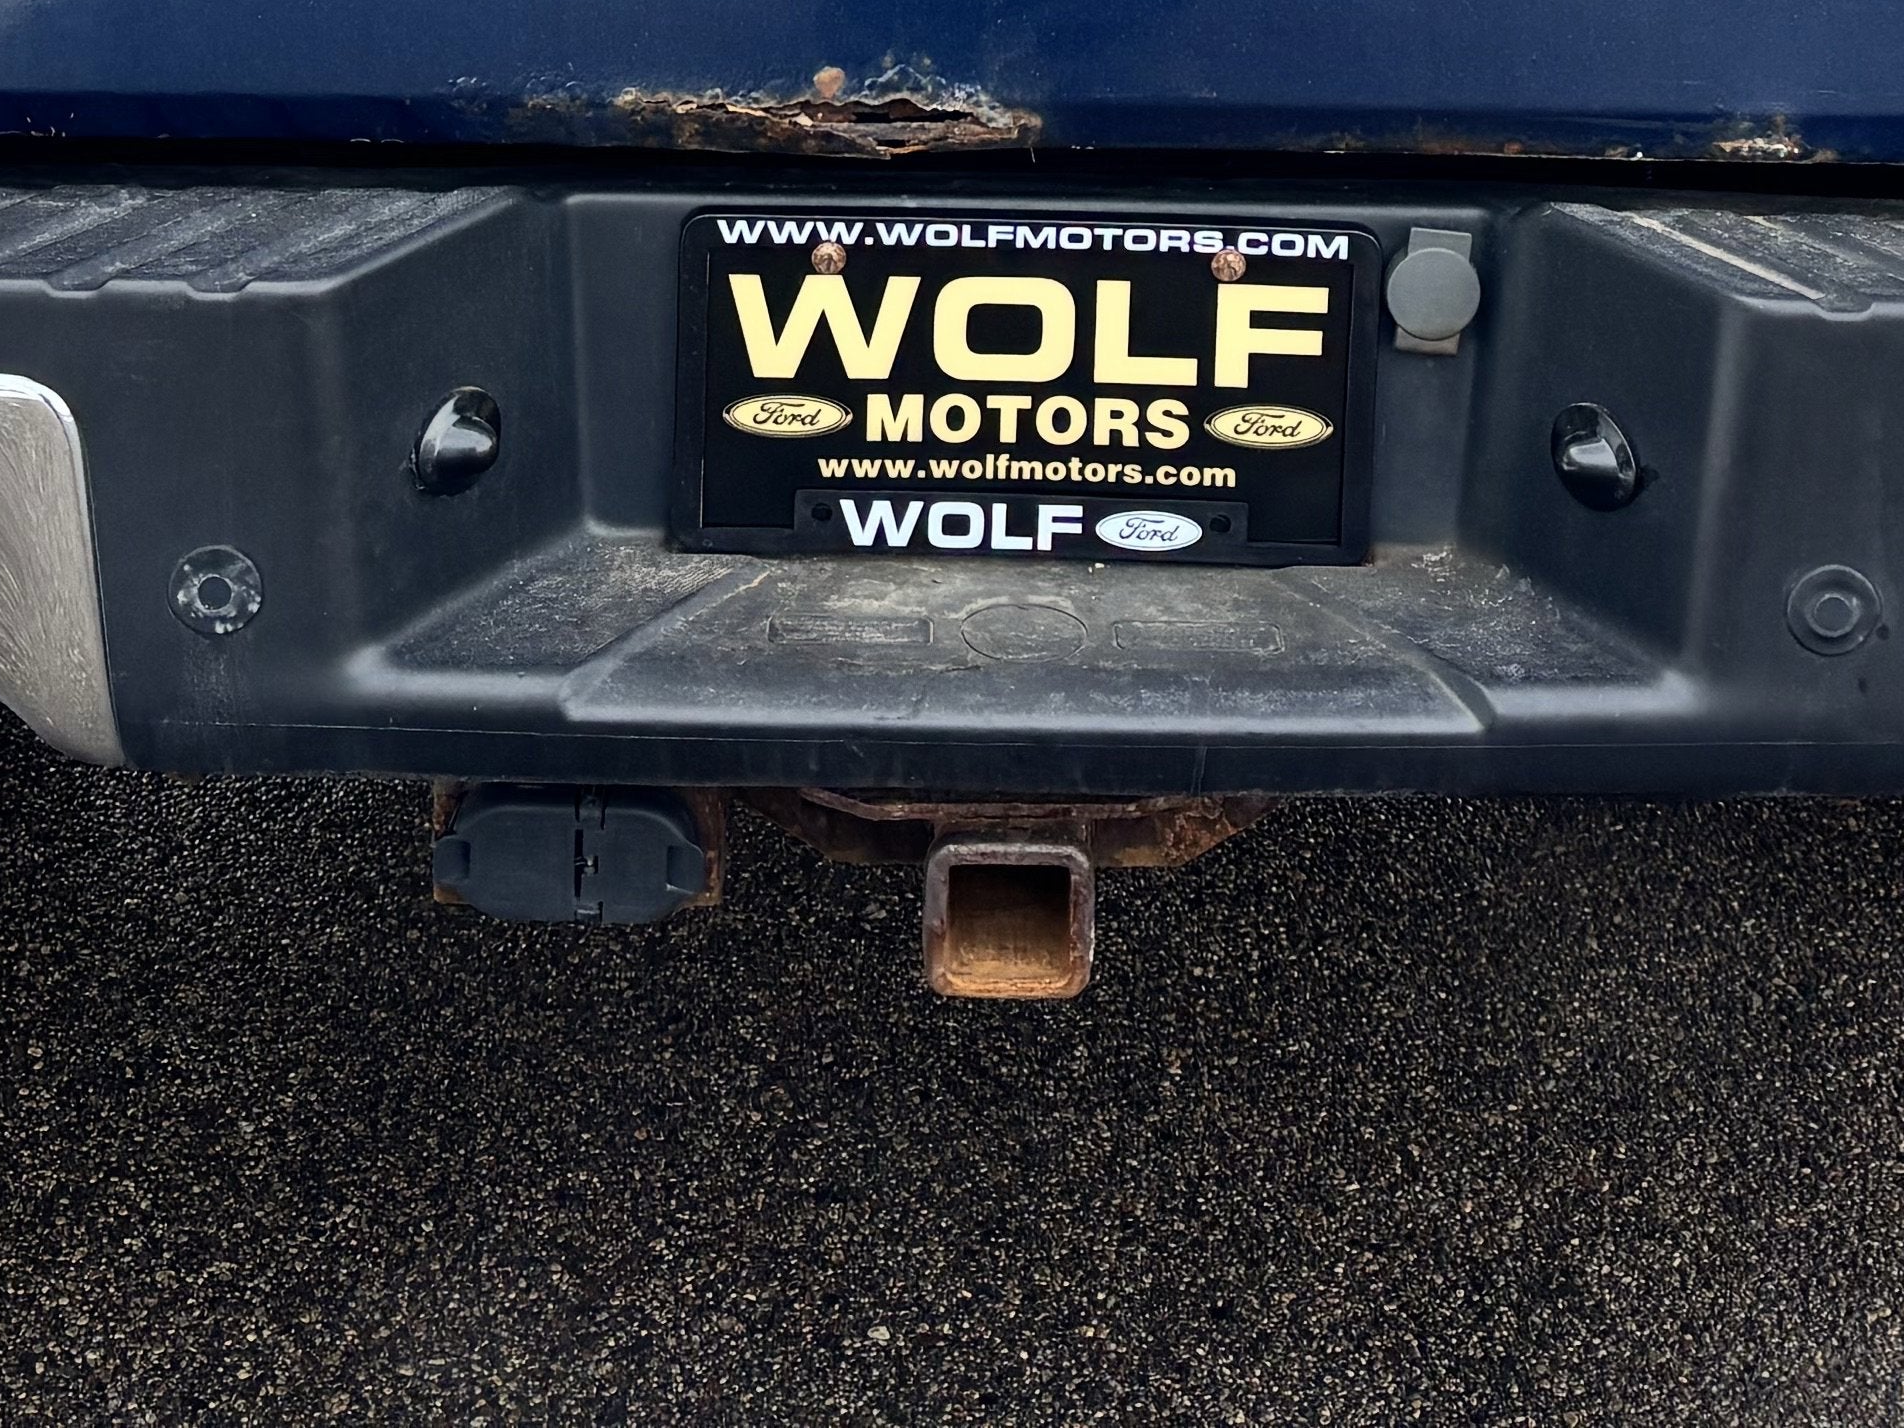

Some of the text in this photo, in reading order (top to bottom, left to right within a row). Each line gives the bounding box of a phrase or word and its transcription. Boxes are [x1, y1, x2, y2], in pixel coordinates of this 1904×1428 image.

[717, 220, 1350, 260] WWW.WOLFMOTORS.COM
[729, 274, 1329, 388] WOLF
[753, 401, 822, 426] Ford
[867, 394, 1189, 449] MOTORS
[1233, 411, 1303, 438] Ford
[818, 454, 1236, 488] www.wolfmotors.com
[840, 499, 1083, 551] WOLF
[1119, 517, 1180, 542] Ford
